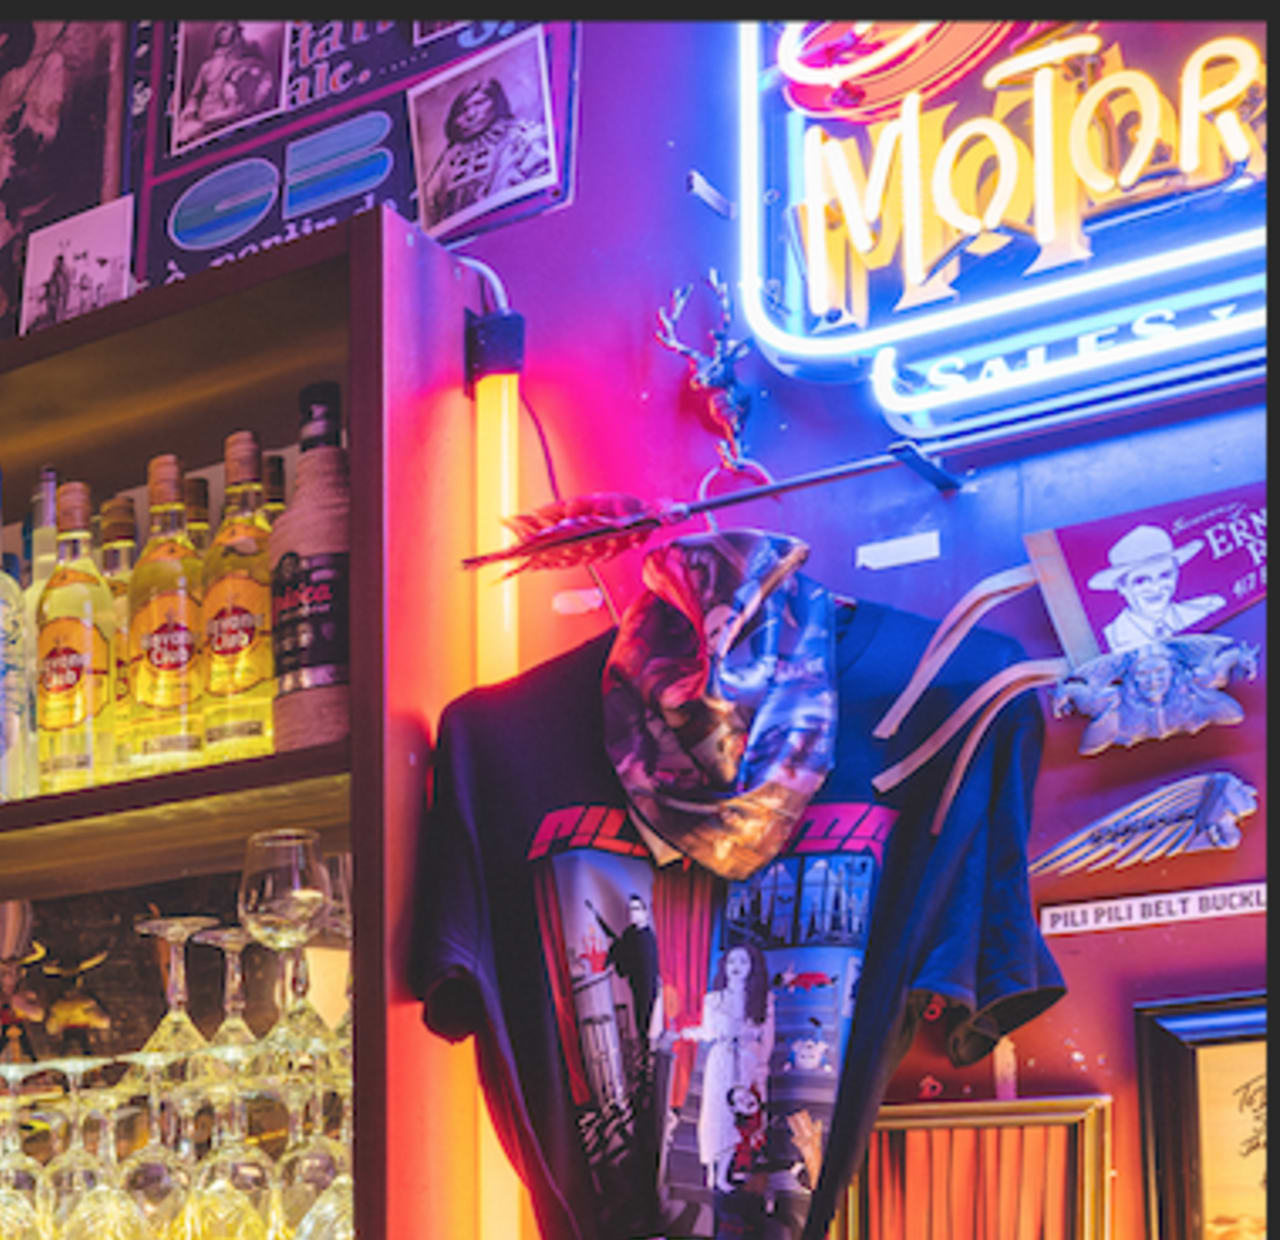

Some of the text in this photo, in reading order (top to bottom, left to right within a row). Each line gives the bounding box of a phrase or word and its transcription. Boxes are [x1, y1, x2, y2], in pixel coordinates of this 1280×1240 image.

[798, 34, 1268, 333] MOTOR
[926, 308, 1178, 392] SALES
[1049, 909, 1090, 929] PILI
[1093, 904, 1134, 924] PILI
[1140, 897, 1191, 920] BELT
